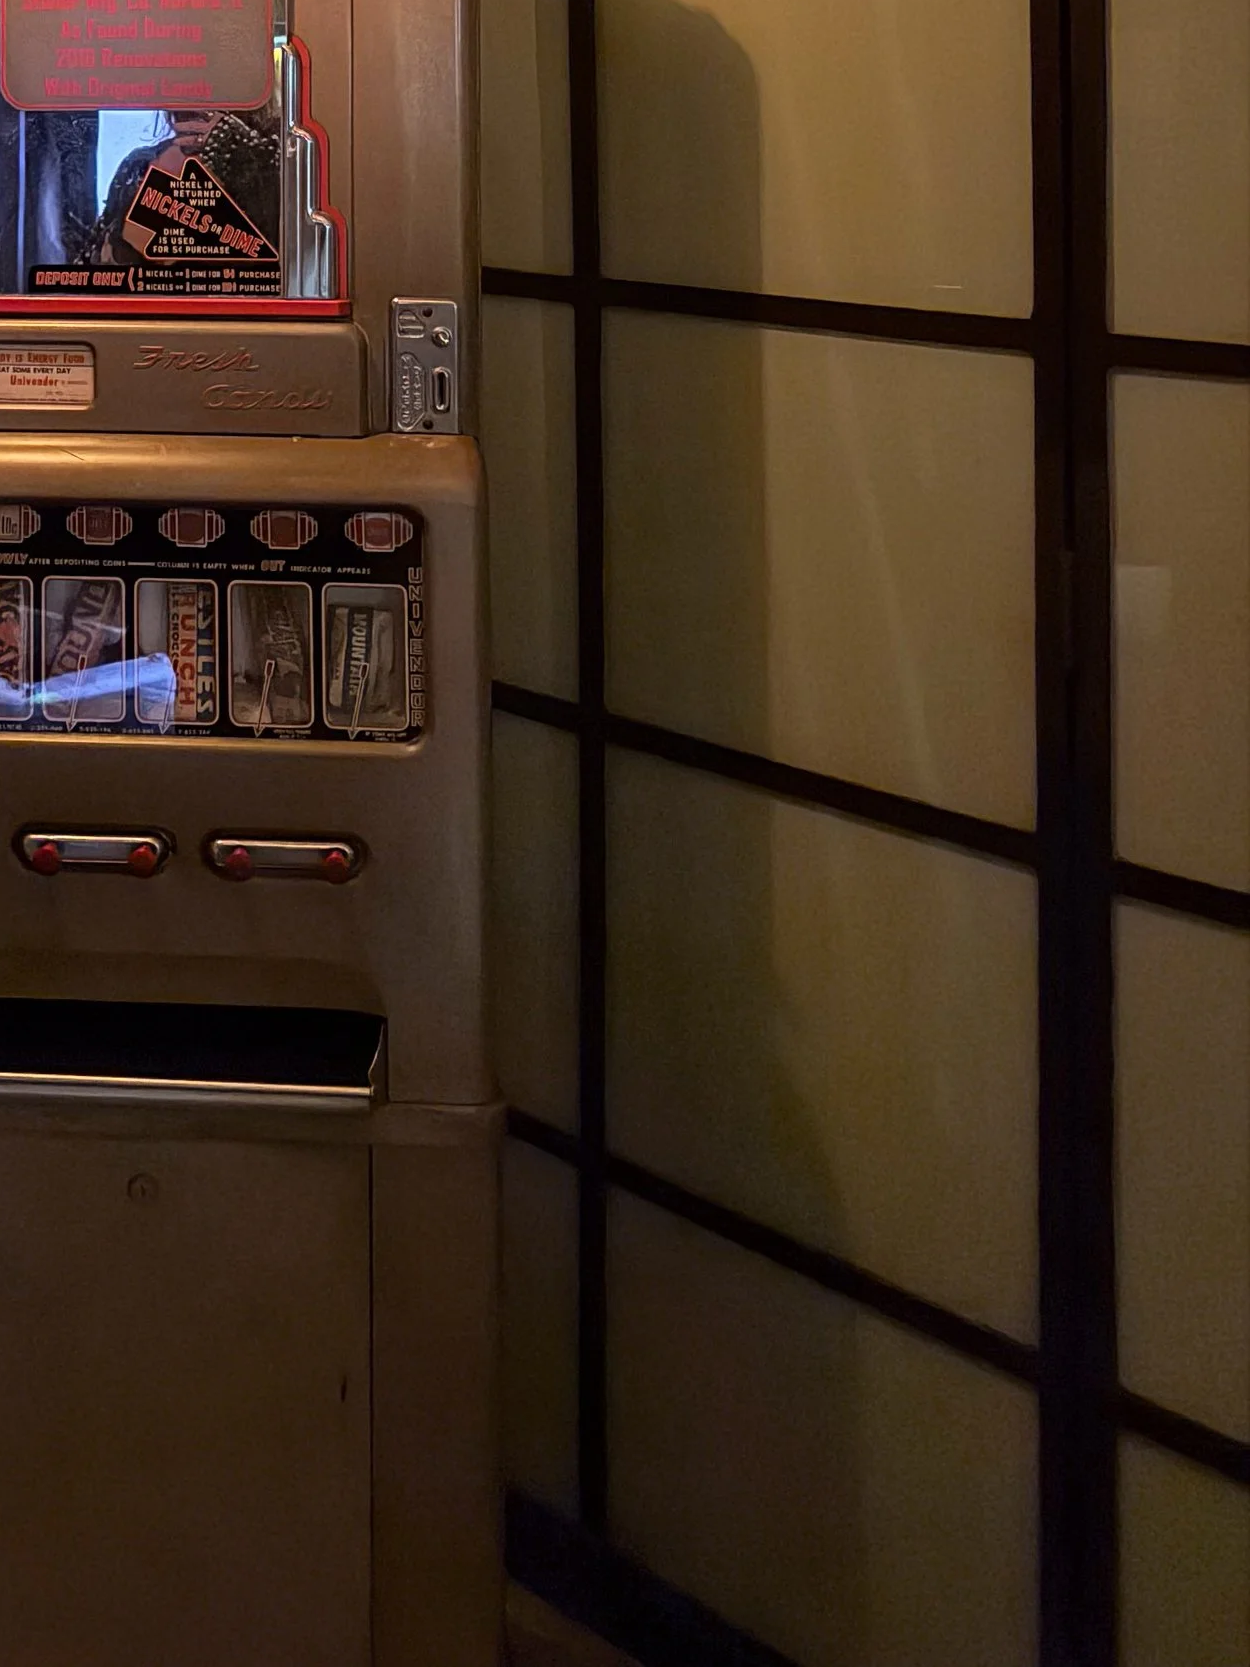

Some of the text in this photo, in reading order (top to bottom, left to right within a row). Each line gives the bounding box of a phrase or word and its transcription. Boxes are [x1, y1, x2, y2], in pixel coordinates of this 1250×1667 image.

[61, 16, 202, 43] As Found During
[100, 48, 207, 68] Renovations
[45, 76, 213, 100] With Original Candy
[189, 172, 197, 180] A
[170, 181, 213, 189] NICKEL IS
[173, 190, 222, 198] RETURNED
[189, 198, 216, 207] WHEN
[140, 186, 264, 258] NICKELS OR DIME
[163, 228, 185, 236] DIME
[158, 237, 195, 245] IS USED
[153, 245, 169, 254] FOR
[185, 246, 230, 254] PURCHASE
[138, 267, 143, 278] 1
[145, 270, 174, 278] NICKEL
[191, 270, 207, 278] DIME
[208, 270, 221, 278] FOR
[239, 271, 281, 279] PURCHASE
[36, 271, 126, 287] DEPOSIT ONLY
[137, 281, 144, 292] 2
[145, 283, 174, 291] NICKELS
[239, 284, 281, 292] PURCHASE
[63, 353, 85, 363] FOOD
[134, 345, 260, 372] Fresh
[10, 375, 58, 387] Univendor
[28, 557, 50, 565] AFTER
[54, 558, 100, 566] DEPOSITING
[102, 559, 126, 567] COINS
[231, 563, 255, 571] WHEN
[261, 559, 286, 572] OUT
[290, 565, 332, 574] INDICATOR
[337, 567, 371, 575] APPEARS
